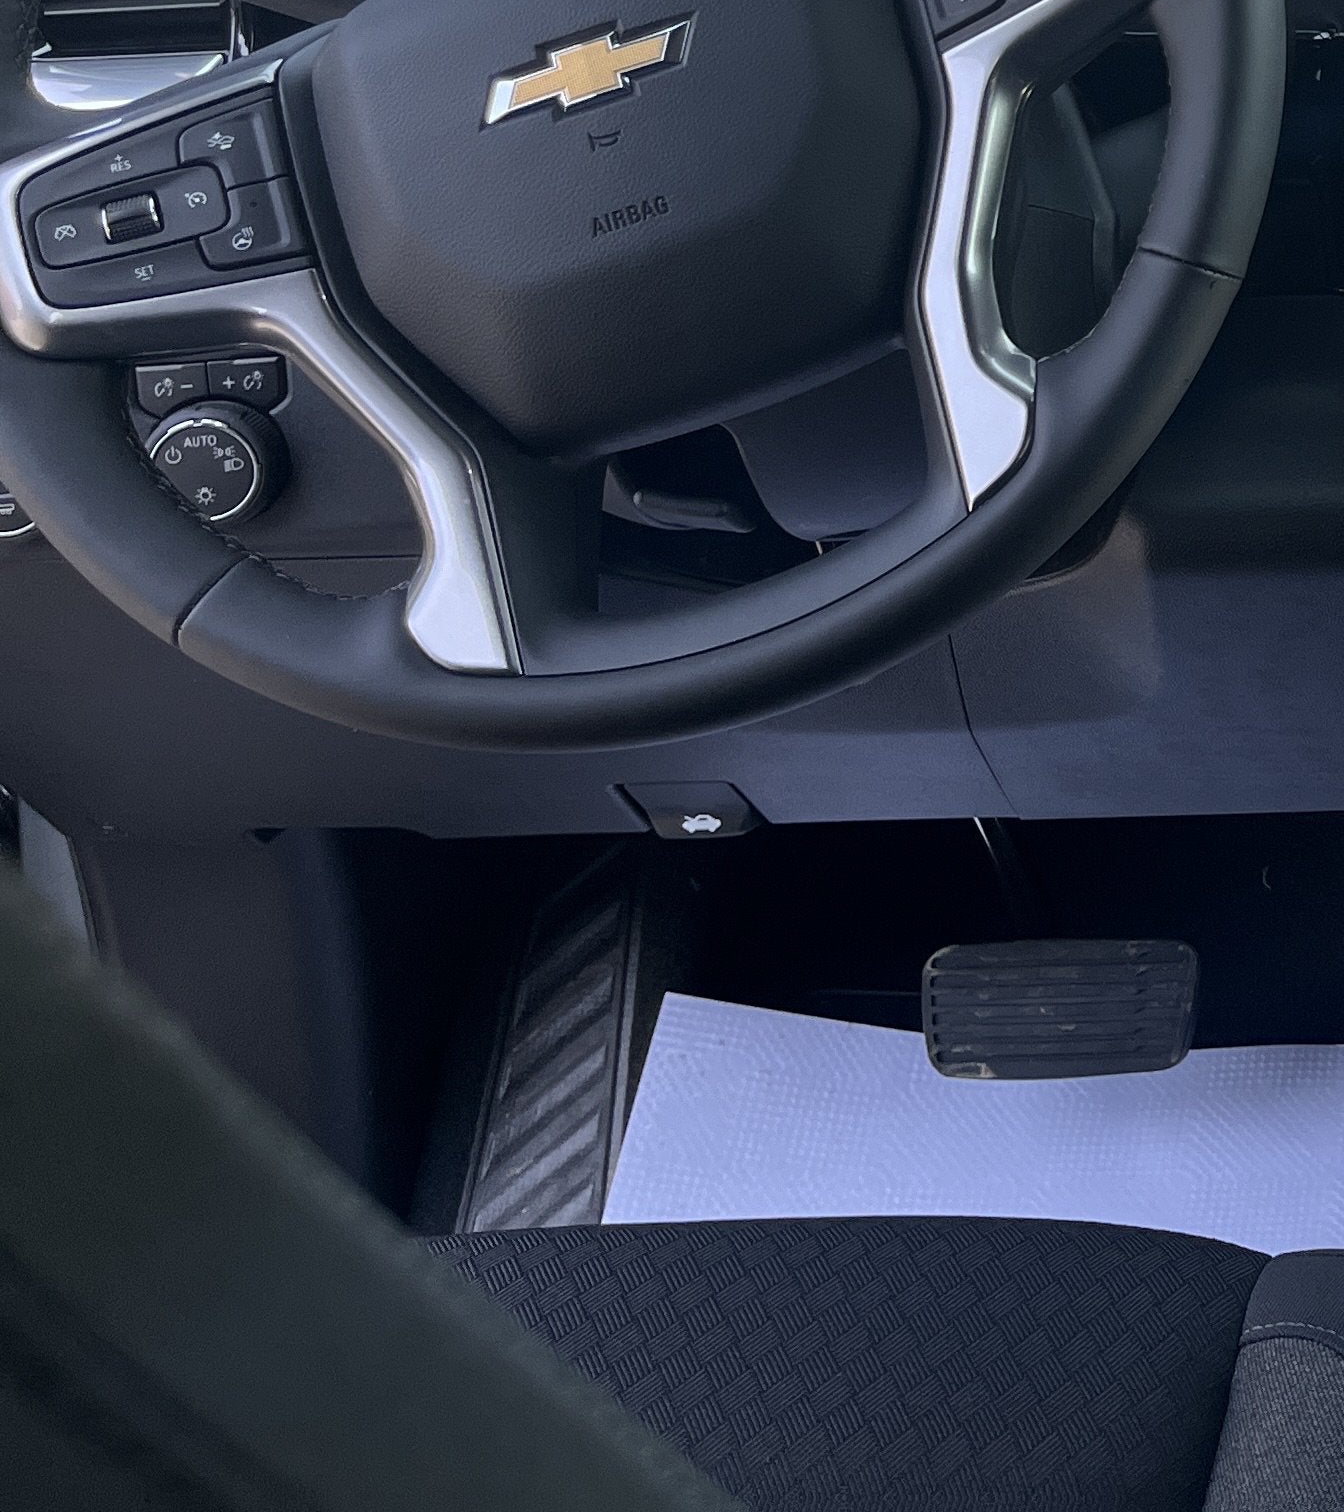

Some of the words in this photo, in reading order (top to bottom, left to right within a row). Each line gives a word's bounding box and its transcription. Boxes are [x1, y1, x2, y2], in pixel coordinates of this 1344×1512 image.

[110, 157, 132, 172] RES
[590, 195, 670, 238] AIRBAG
[134, 264, 155, 280] SET
[183, 433, 217, 449] AUTO
